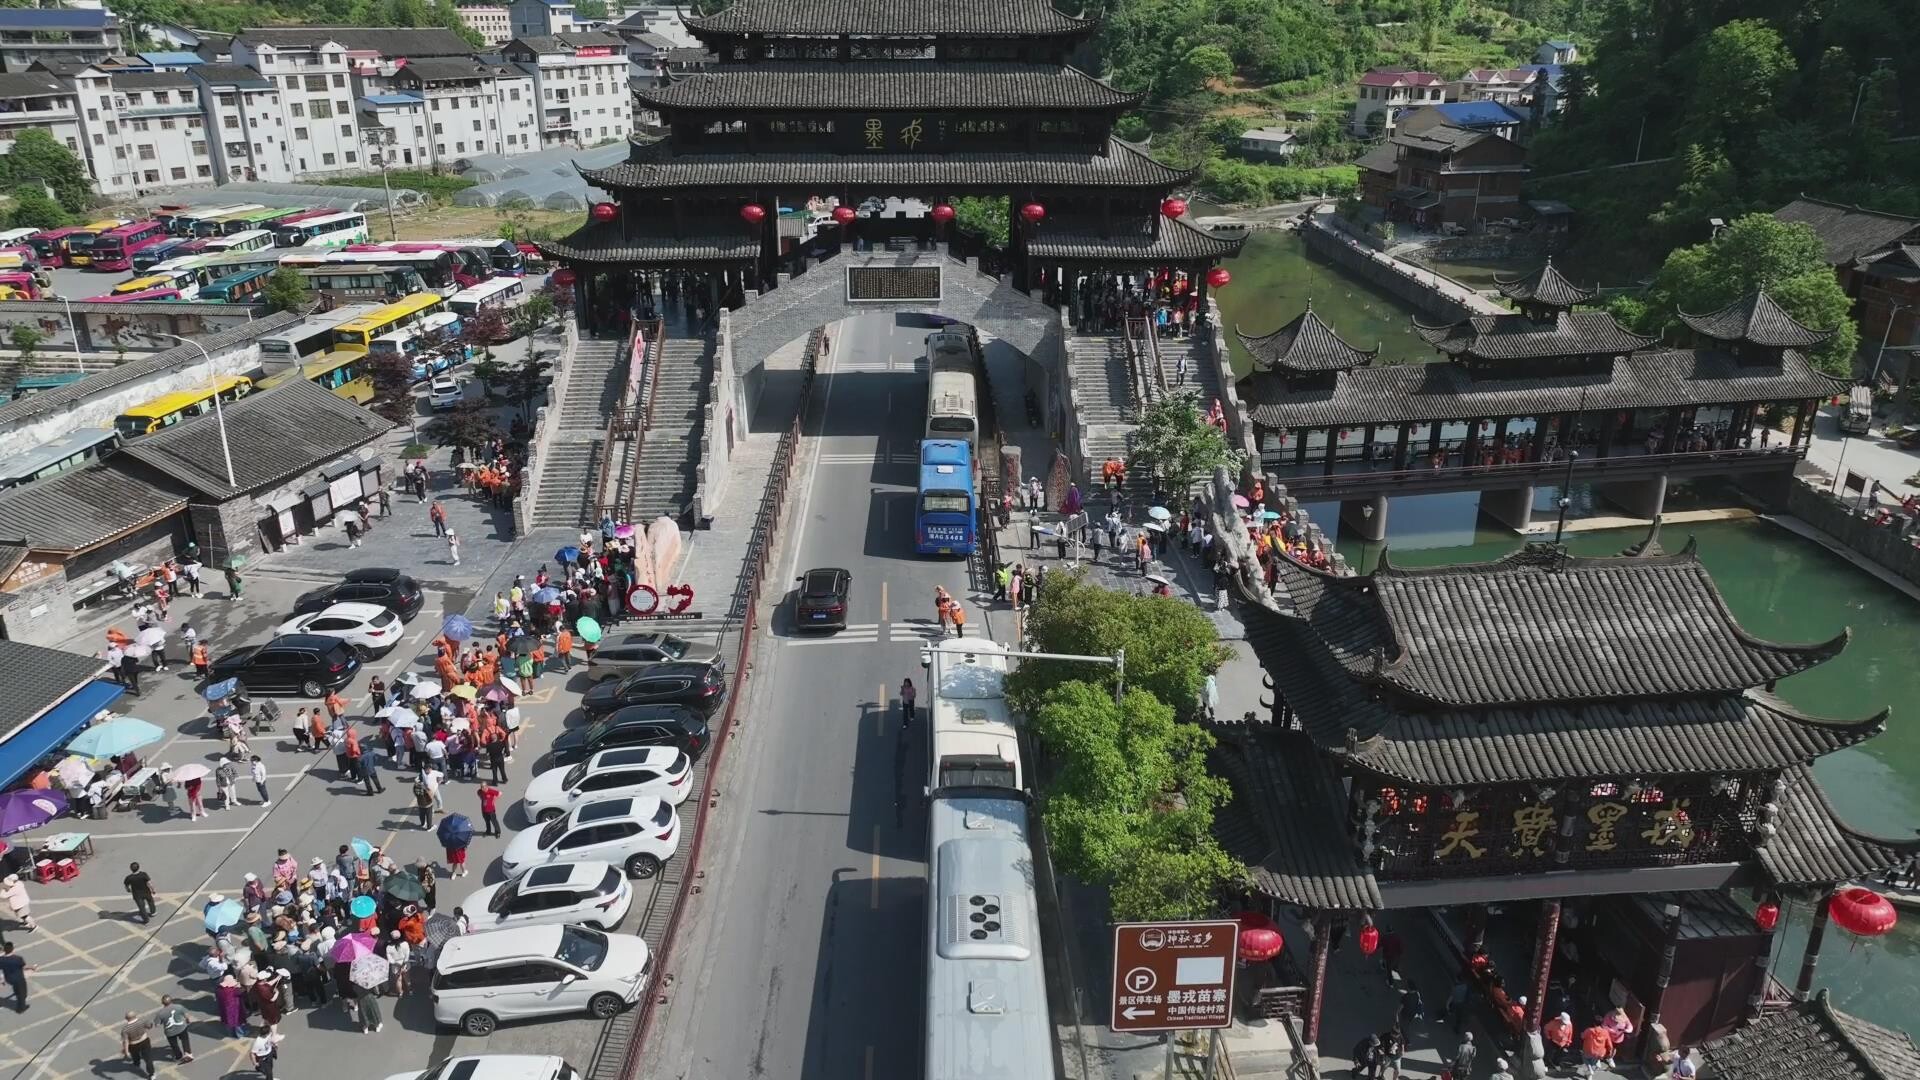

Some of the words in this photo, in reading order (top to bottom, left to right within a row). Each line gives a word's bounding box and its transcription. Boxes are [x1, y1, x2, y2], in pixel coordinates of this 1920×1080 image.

[1135, 975, 1149, 990] P
[1119, 995, 1162, 1005] 景区停车场
[1167, 989, 1226, 1003] 墨戎苗寨
[1168, 1004, 1225, 1015] 中国传统村落
